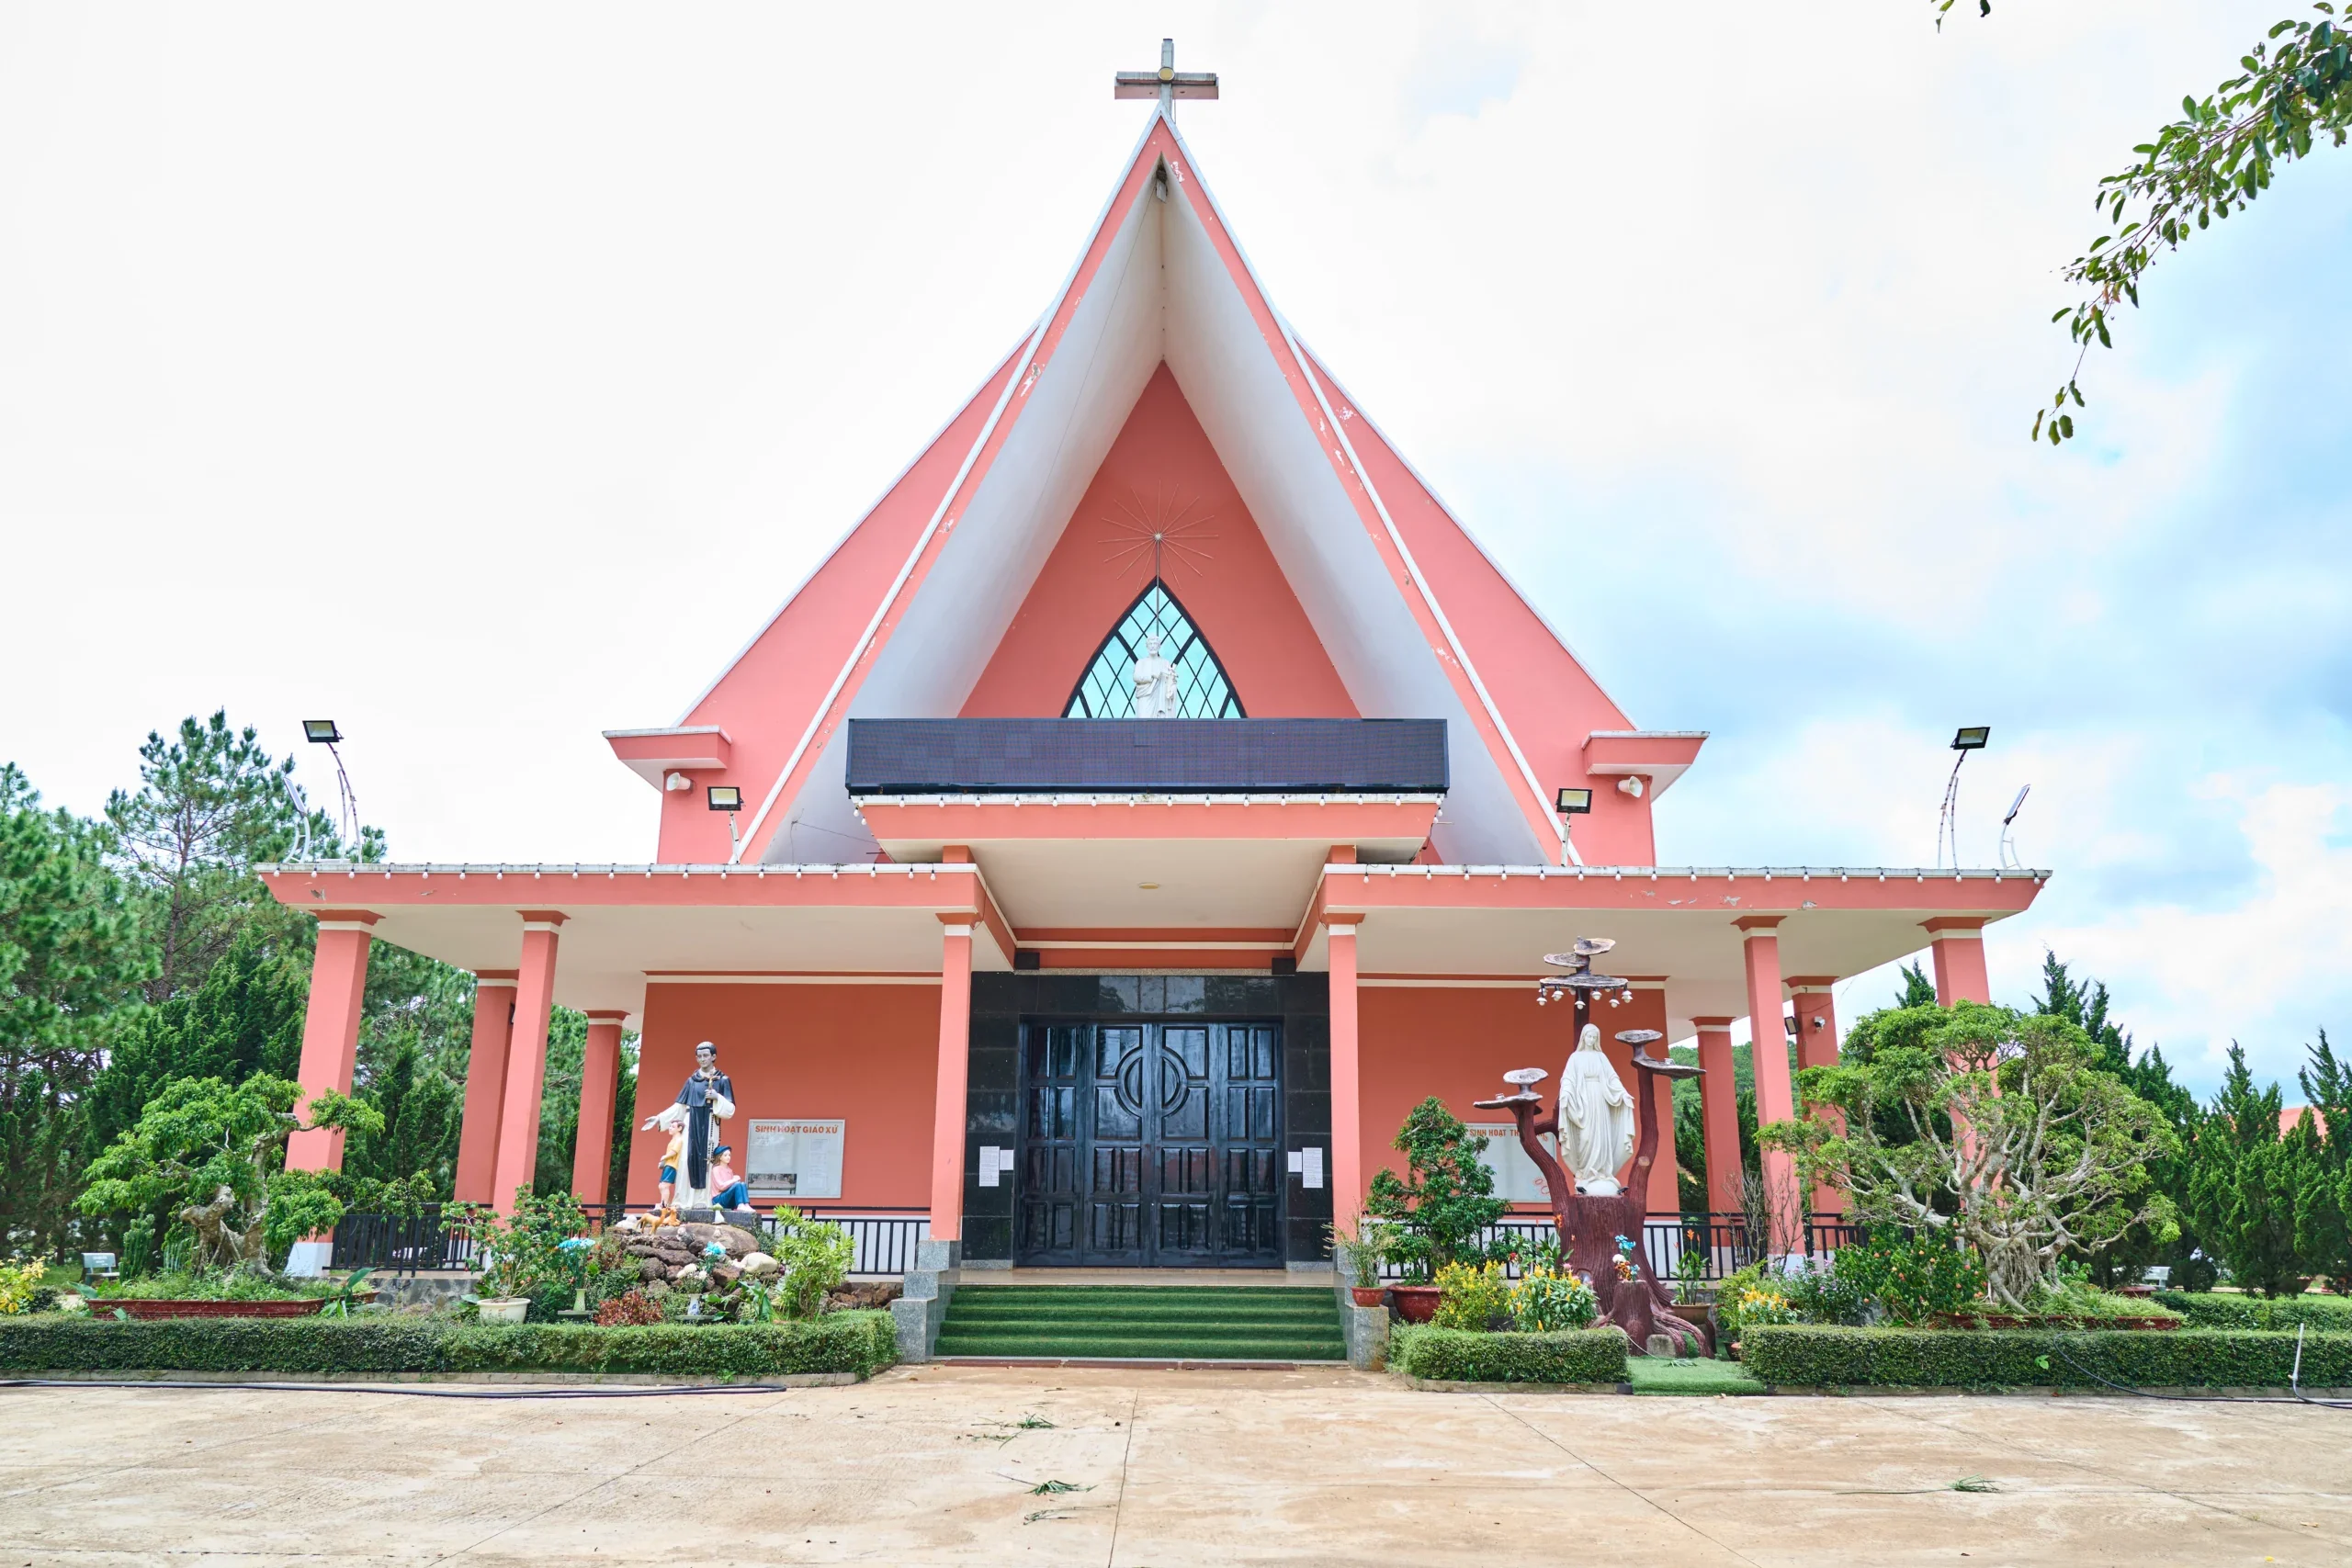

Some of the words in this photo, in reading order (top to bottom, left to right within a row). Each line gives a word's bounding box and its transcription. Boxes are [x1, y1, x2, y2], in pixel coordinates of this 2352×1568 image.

[802, 1124, 824, 1134] GIÁO
[825, 1124, 839, 1134] XỨ
[1489, 1129, 1506, 1137] HOẠT
